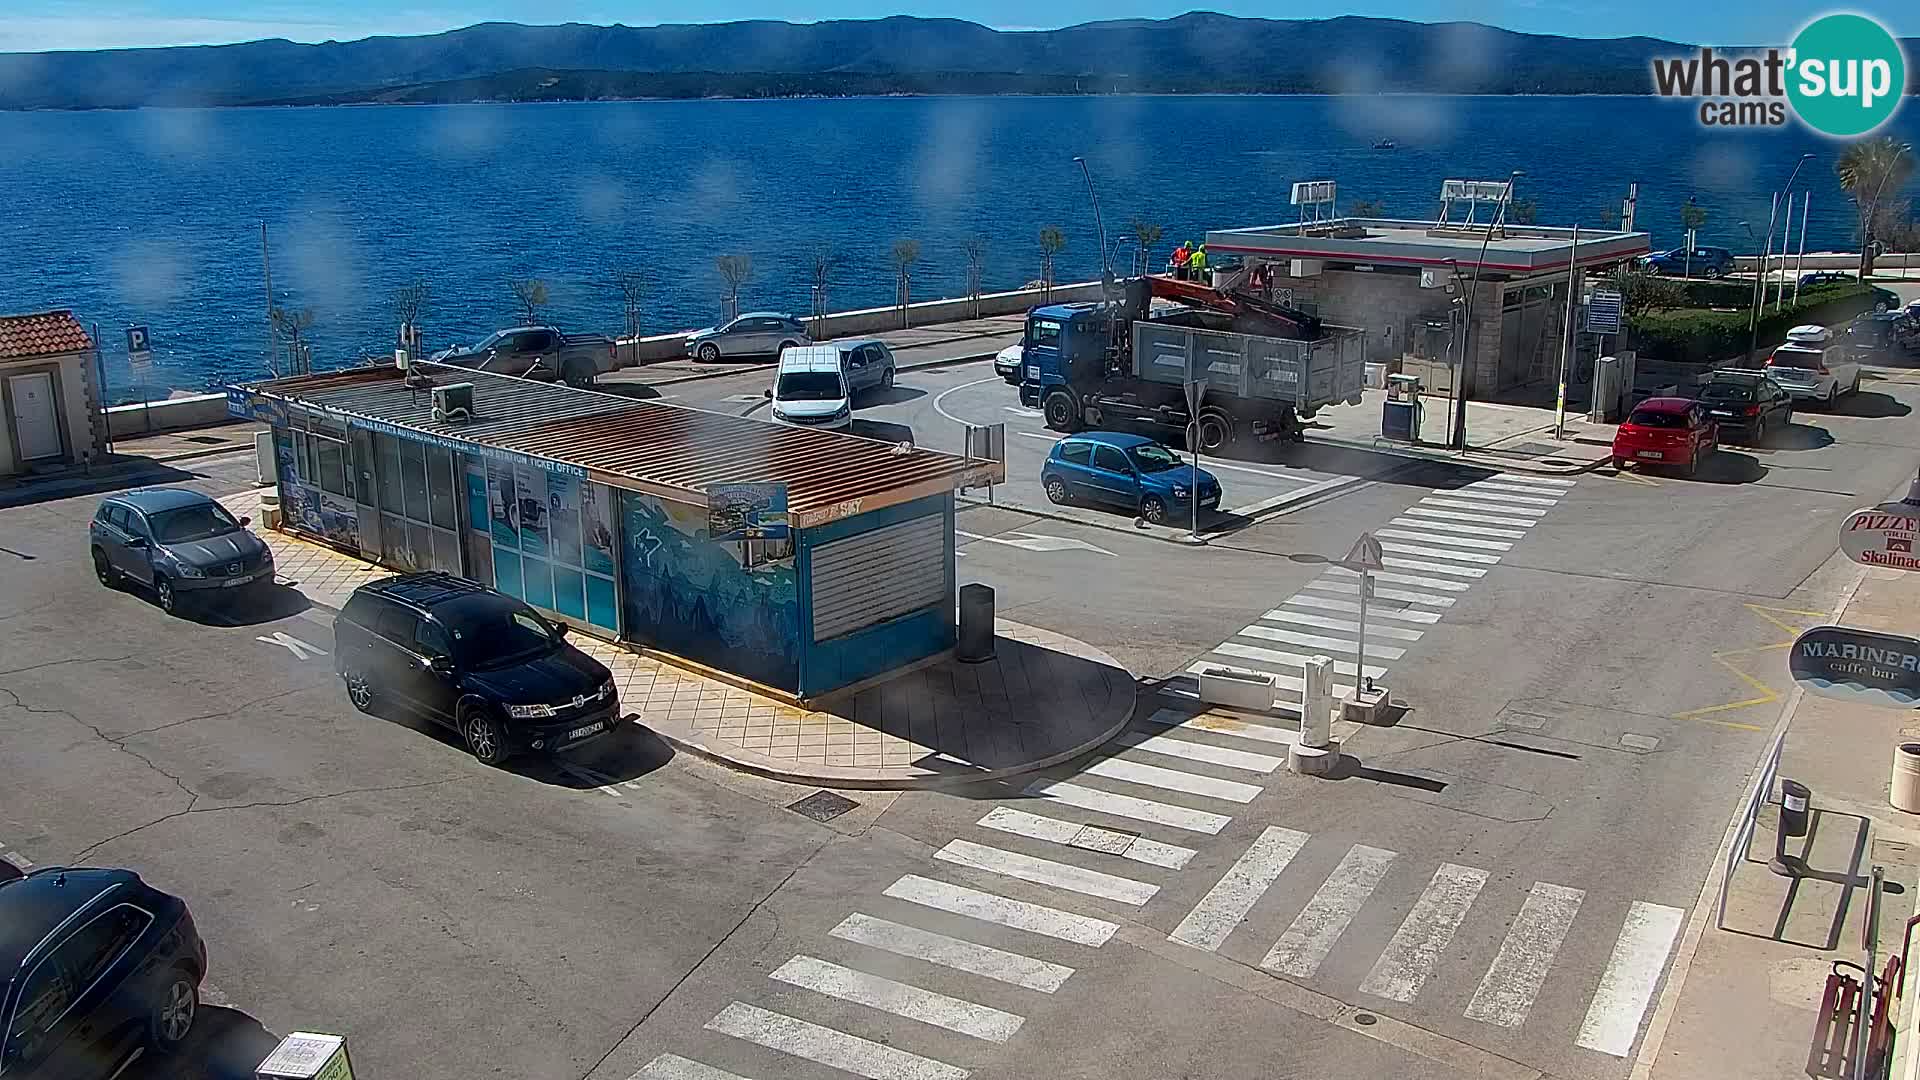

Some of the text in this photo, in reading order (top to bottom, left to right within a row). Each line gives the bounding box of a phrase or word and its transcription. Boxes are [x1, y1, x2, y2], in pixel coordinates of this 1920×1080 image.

[131, 330, 144, 349] P
[480, 447, 494, 457] BUS
[495, 449, 527, 465] STATION
[530, 458, 555, 471] TICKET
[556, 463, 584, 477] OFFICE
[1849, 515, 1920, 533] PIZZE
[1802, 642, 1920, 672] MARINER
[1830, 663, 1899, 680] caffe bar
